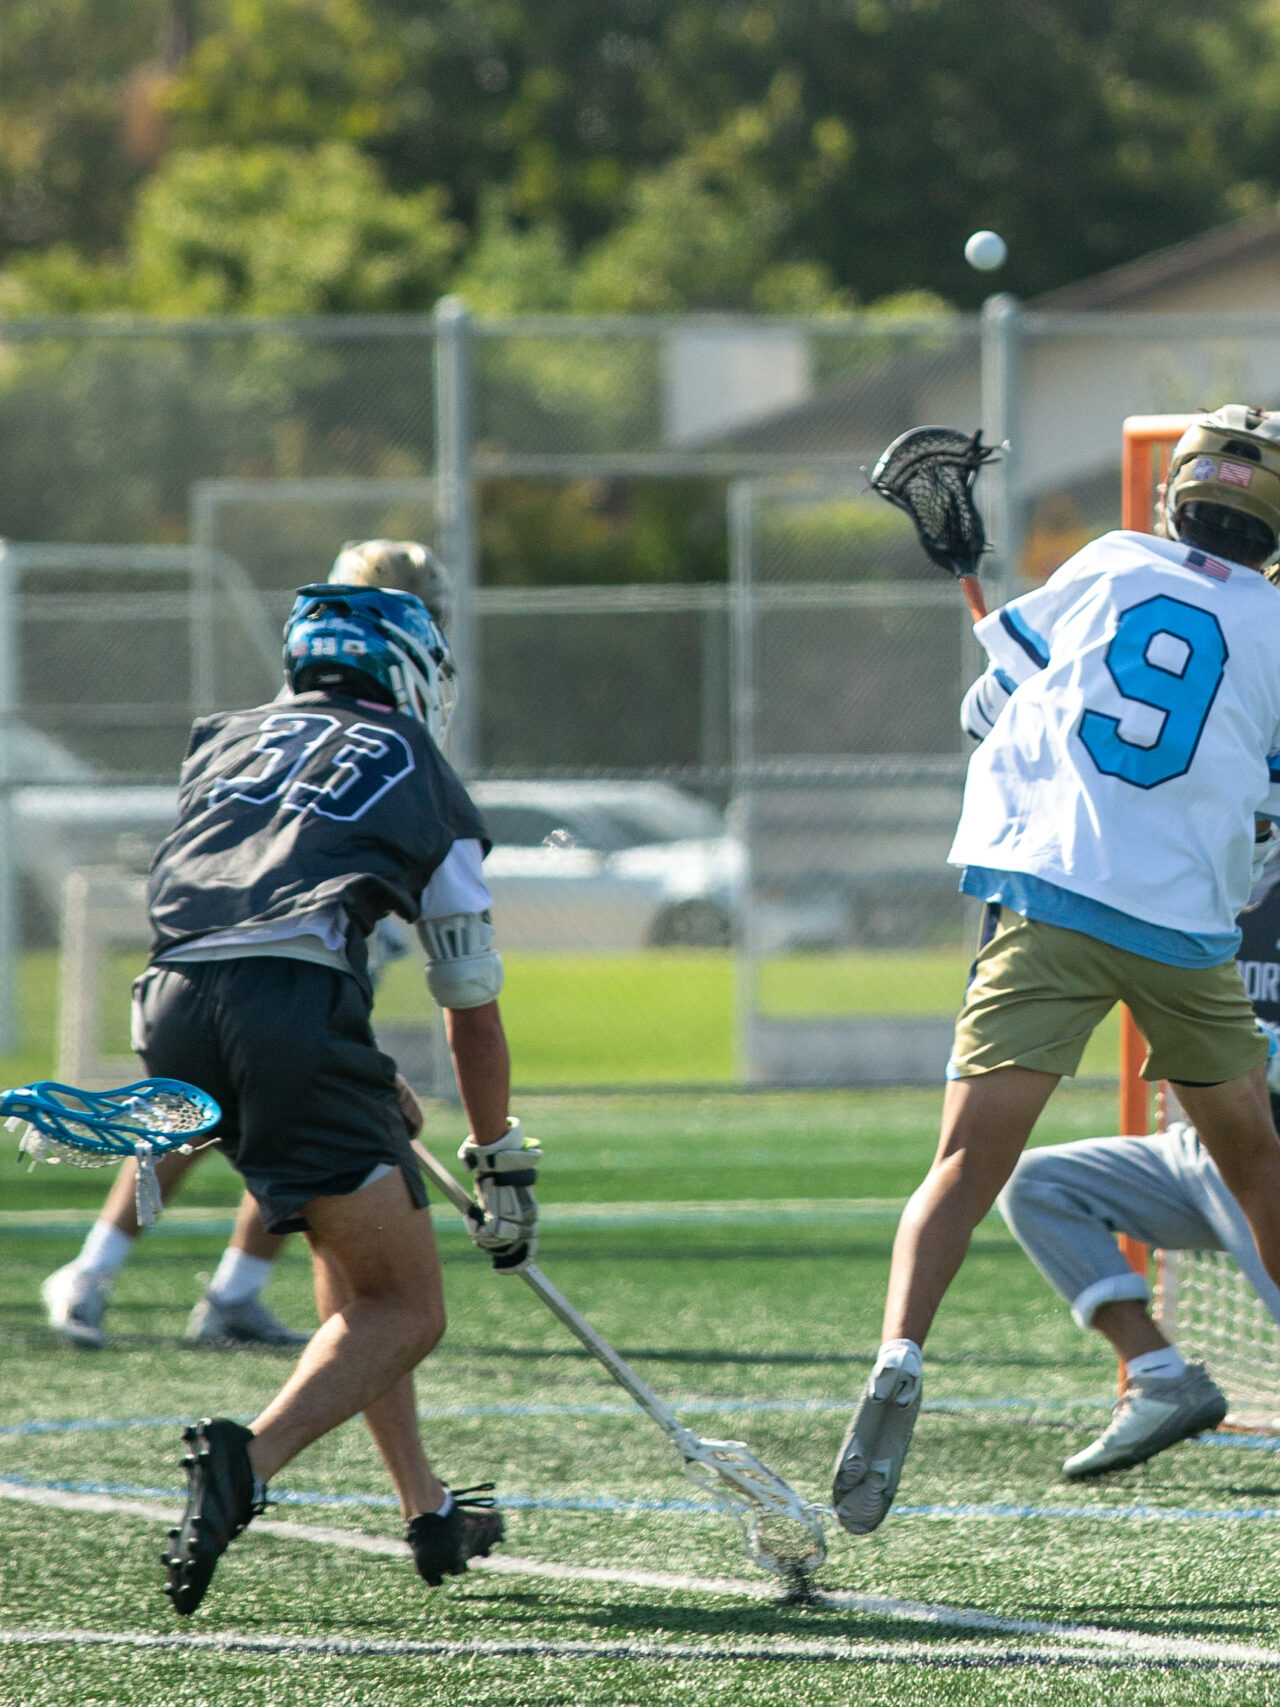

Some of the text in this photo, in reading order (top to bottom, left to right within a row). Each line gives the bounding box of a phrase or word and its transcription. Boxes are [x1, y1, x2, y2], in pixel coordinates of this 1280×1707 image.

[310, 636, 338, 656] 33
[1078, 593, 1230, 790] 9
[208, 713, 415, 821] 33
